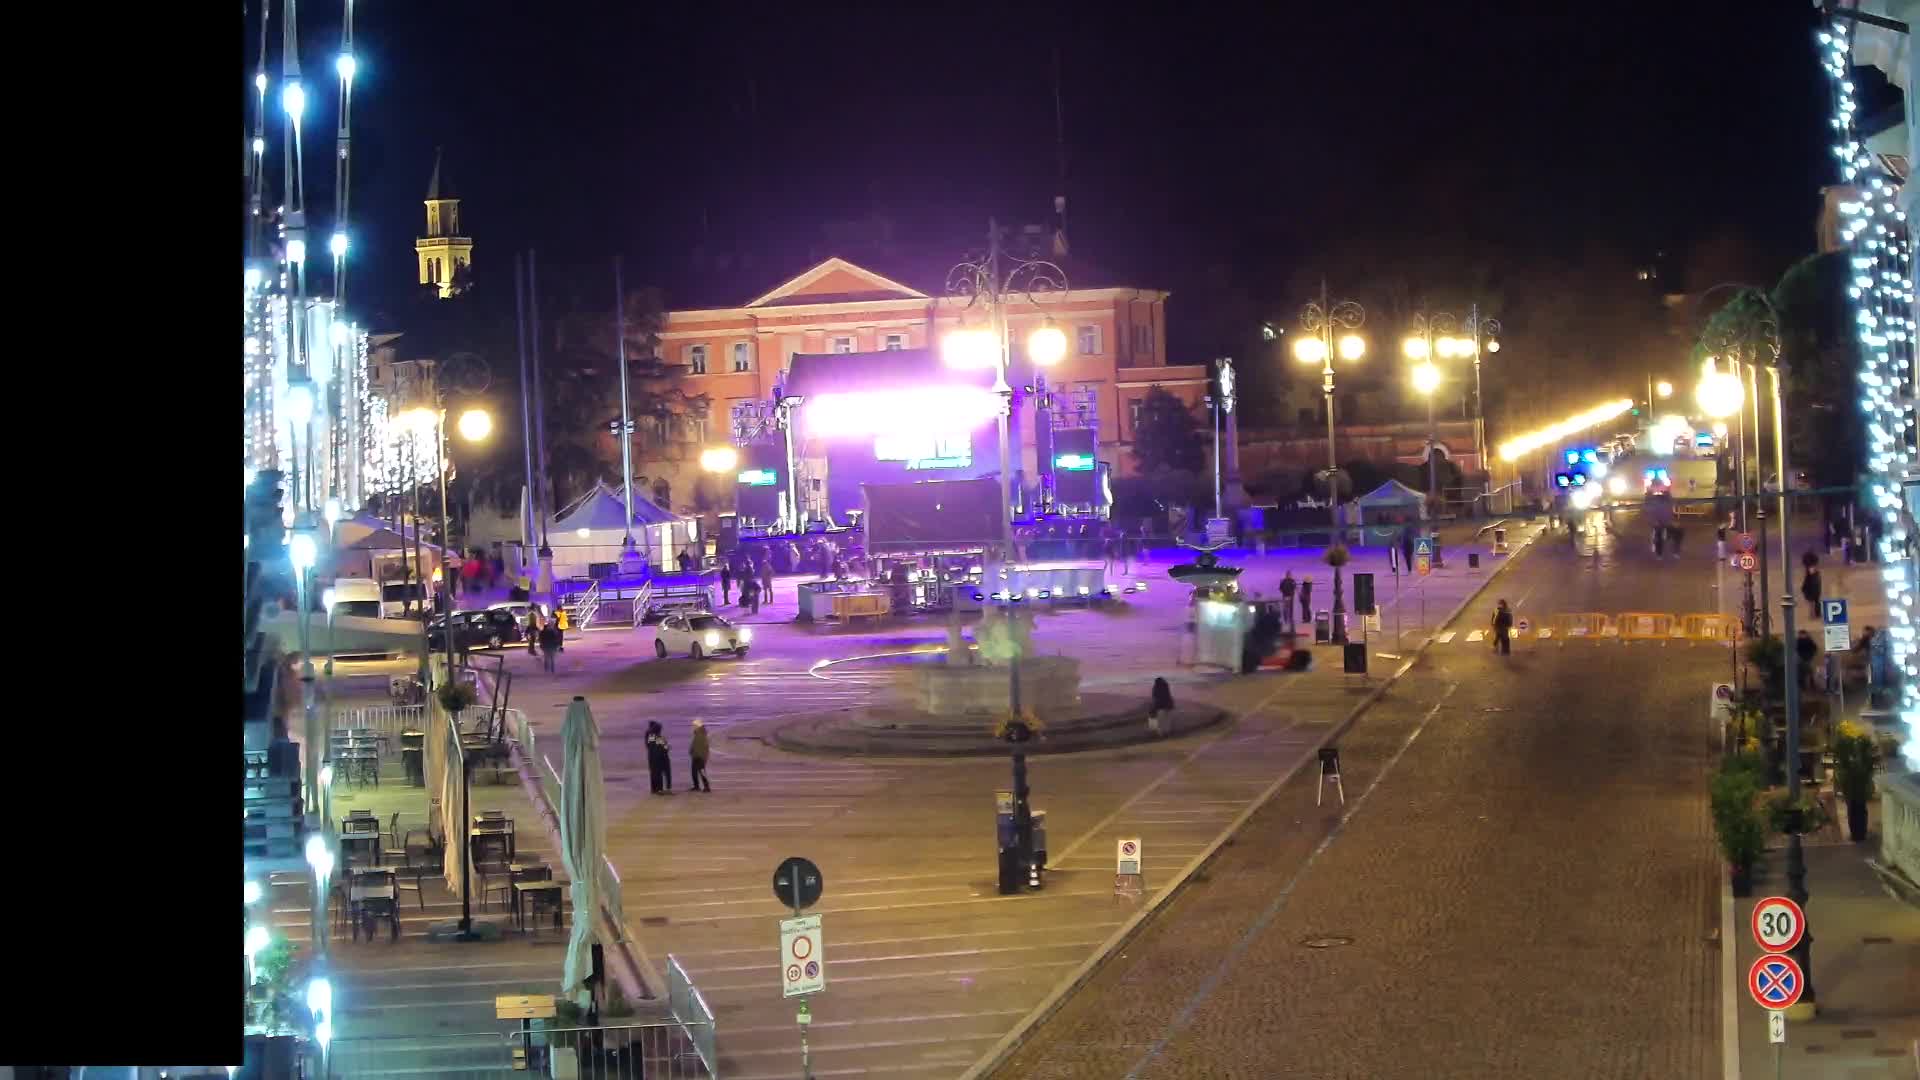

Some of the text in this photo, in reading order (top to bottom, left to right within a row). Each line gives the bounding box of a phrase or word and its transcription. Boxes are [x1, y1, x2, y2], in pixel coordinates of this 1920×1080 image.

[1743, 558, 1752, 566] 20
[1827, 602, 1842, 621] P
[1762, 912, 1791, 937] 30
